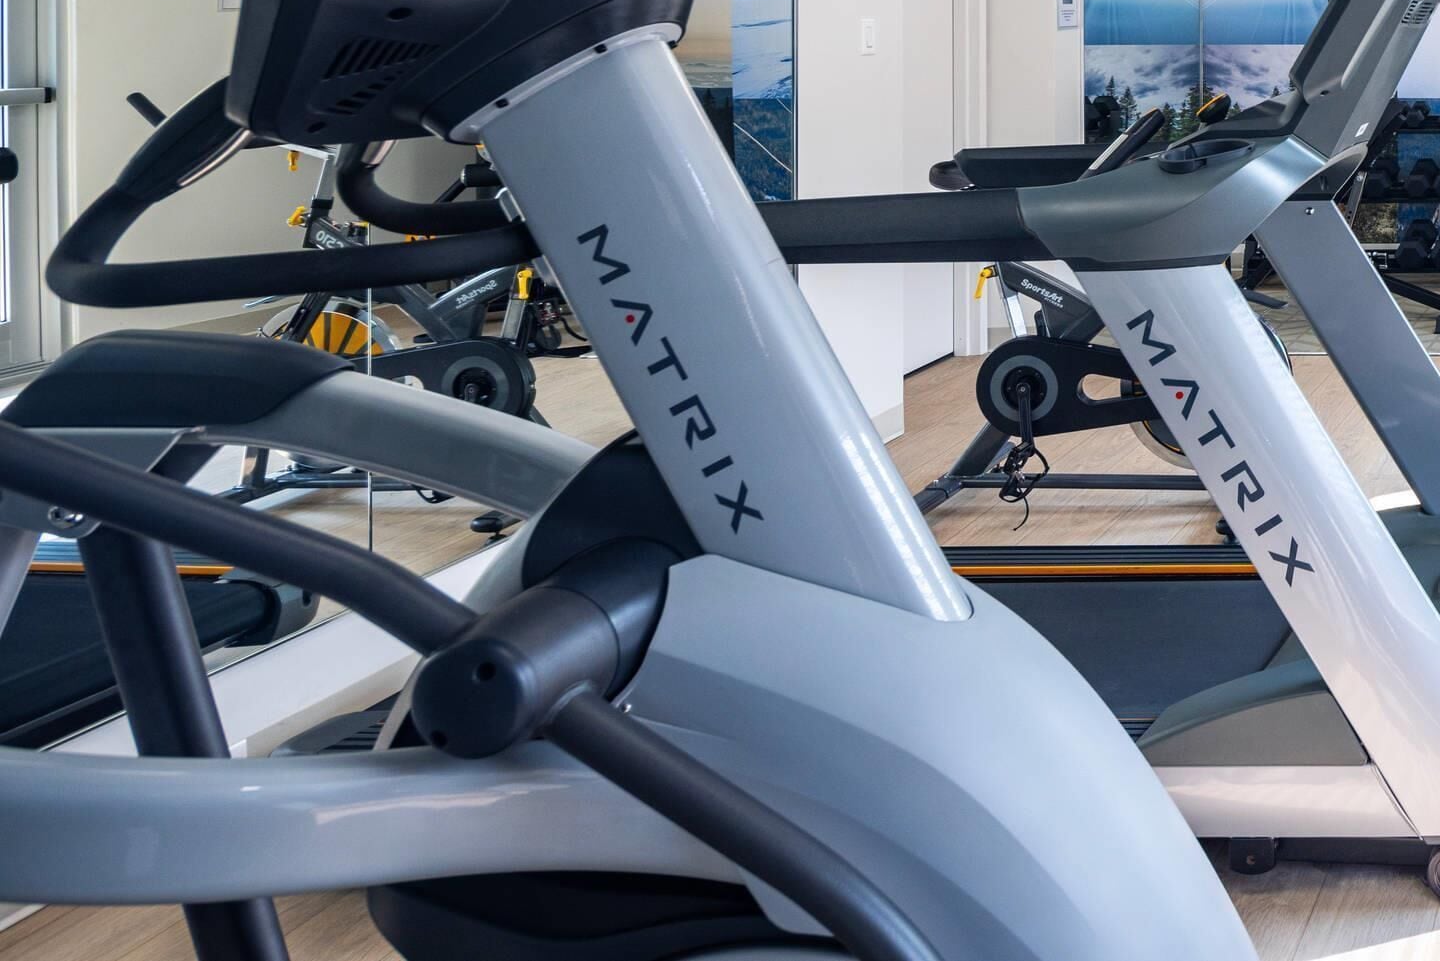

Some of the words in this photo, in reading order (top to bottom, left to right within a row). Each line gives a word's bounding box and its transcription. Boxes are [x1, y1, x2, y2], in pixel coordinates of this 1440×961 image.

[577, 224, 764, 535] MATRIX
[1020, 278, 1064, 304] SportsArt
[1126, 309, 1315, 588] MATRIX
